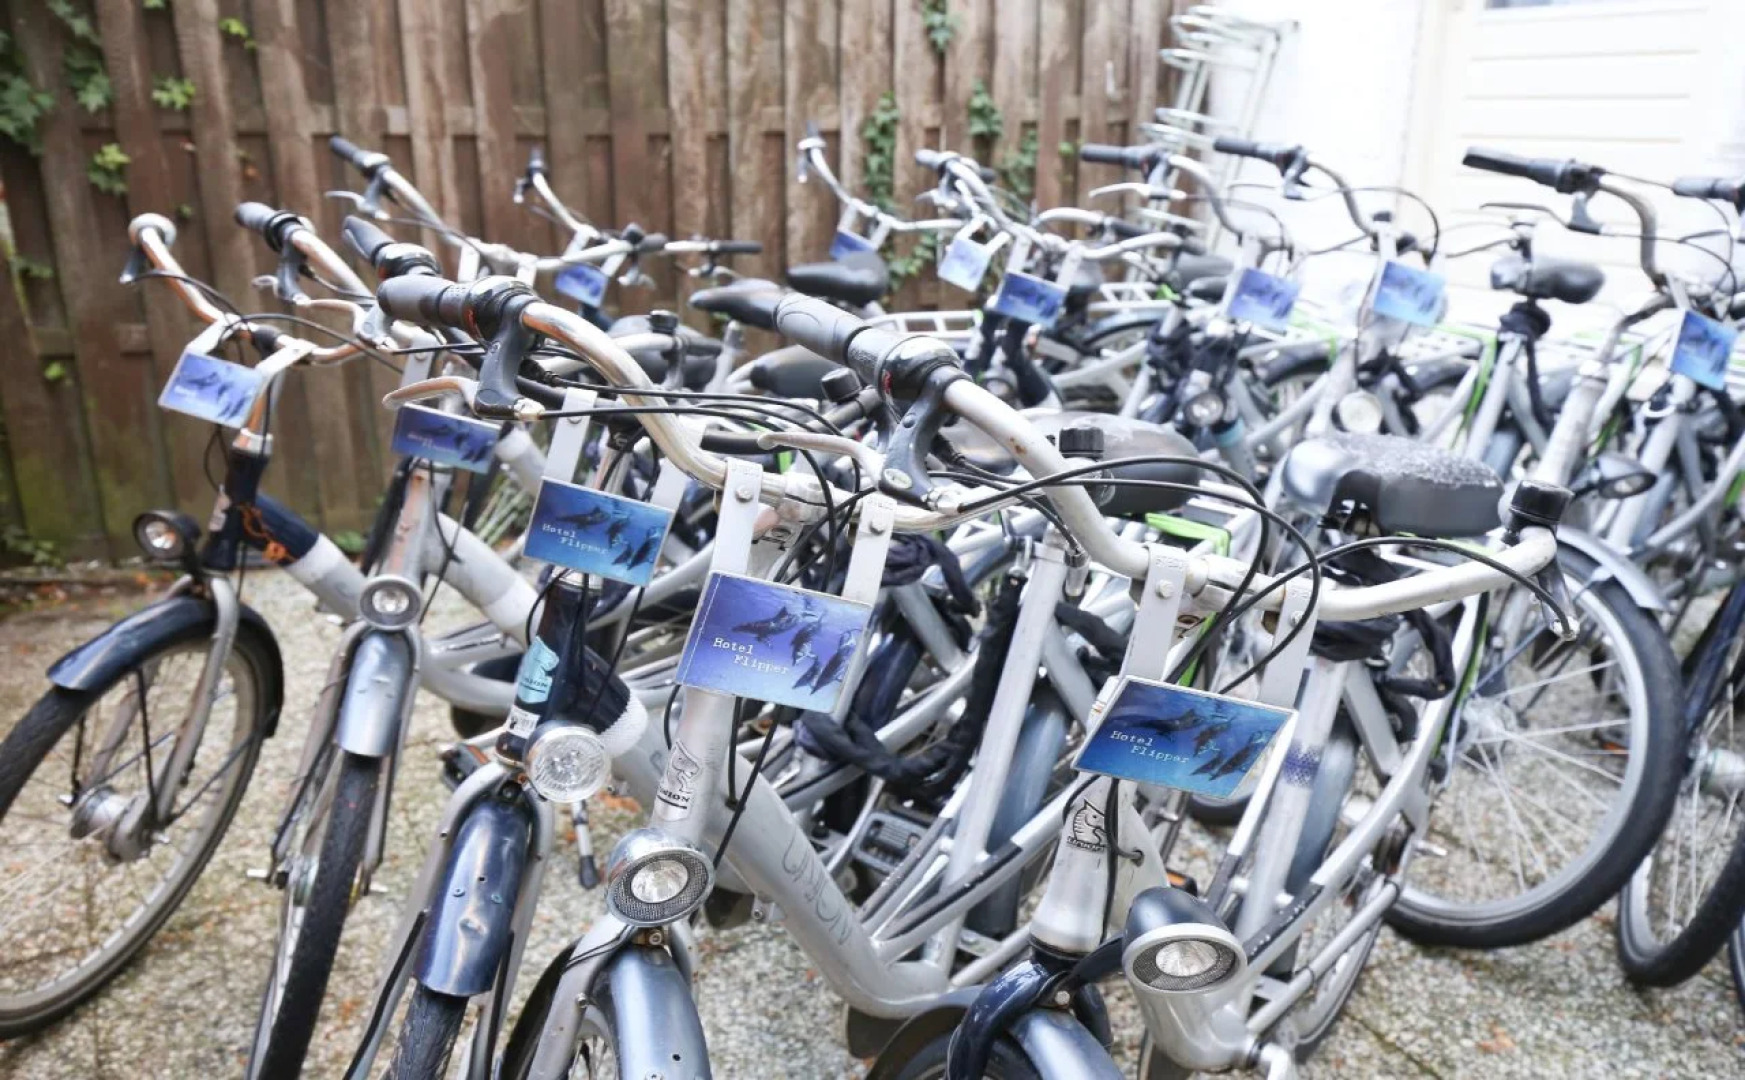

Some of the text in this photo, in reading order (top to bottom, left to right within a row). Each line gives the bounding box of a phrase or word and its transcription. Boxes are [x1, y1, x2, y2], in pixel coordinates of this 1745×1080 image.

[542, 523, 576, 538] Hotel
[560, 536, 609, 555] Flipper
[712, 637, 754, 655] Hotel
[734, 654, 789, 676] Flipper
[1110, 730, 1154, 747] Hotel
[1130, 745, 1190, 764] Flipper
